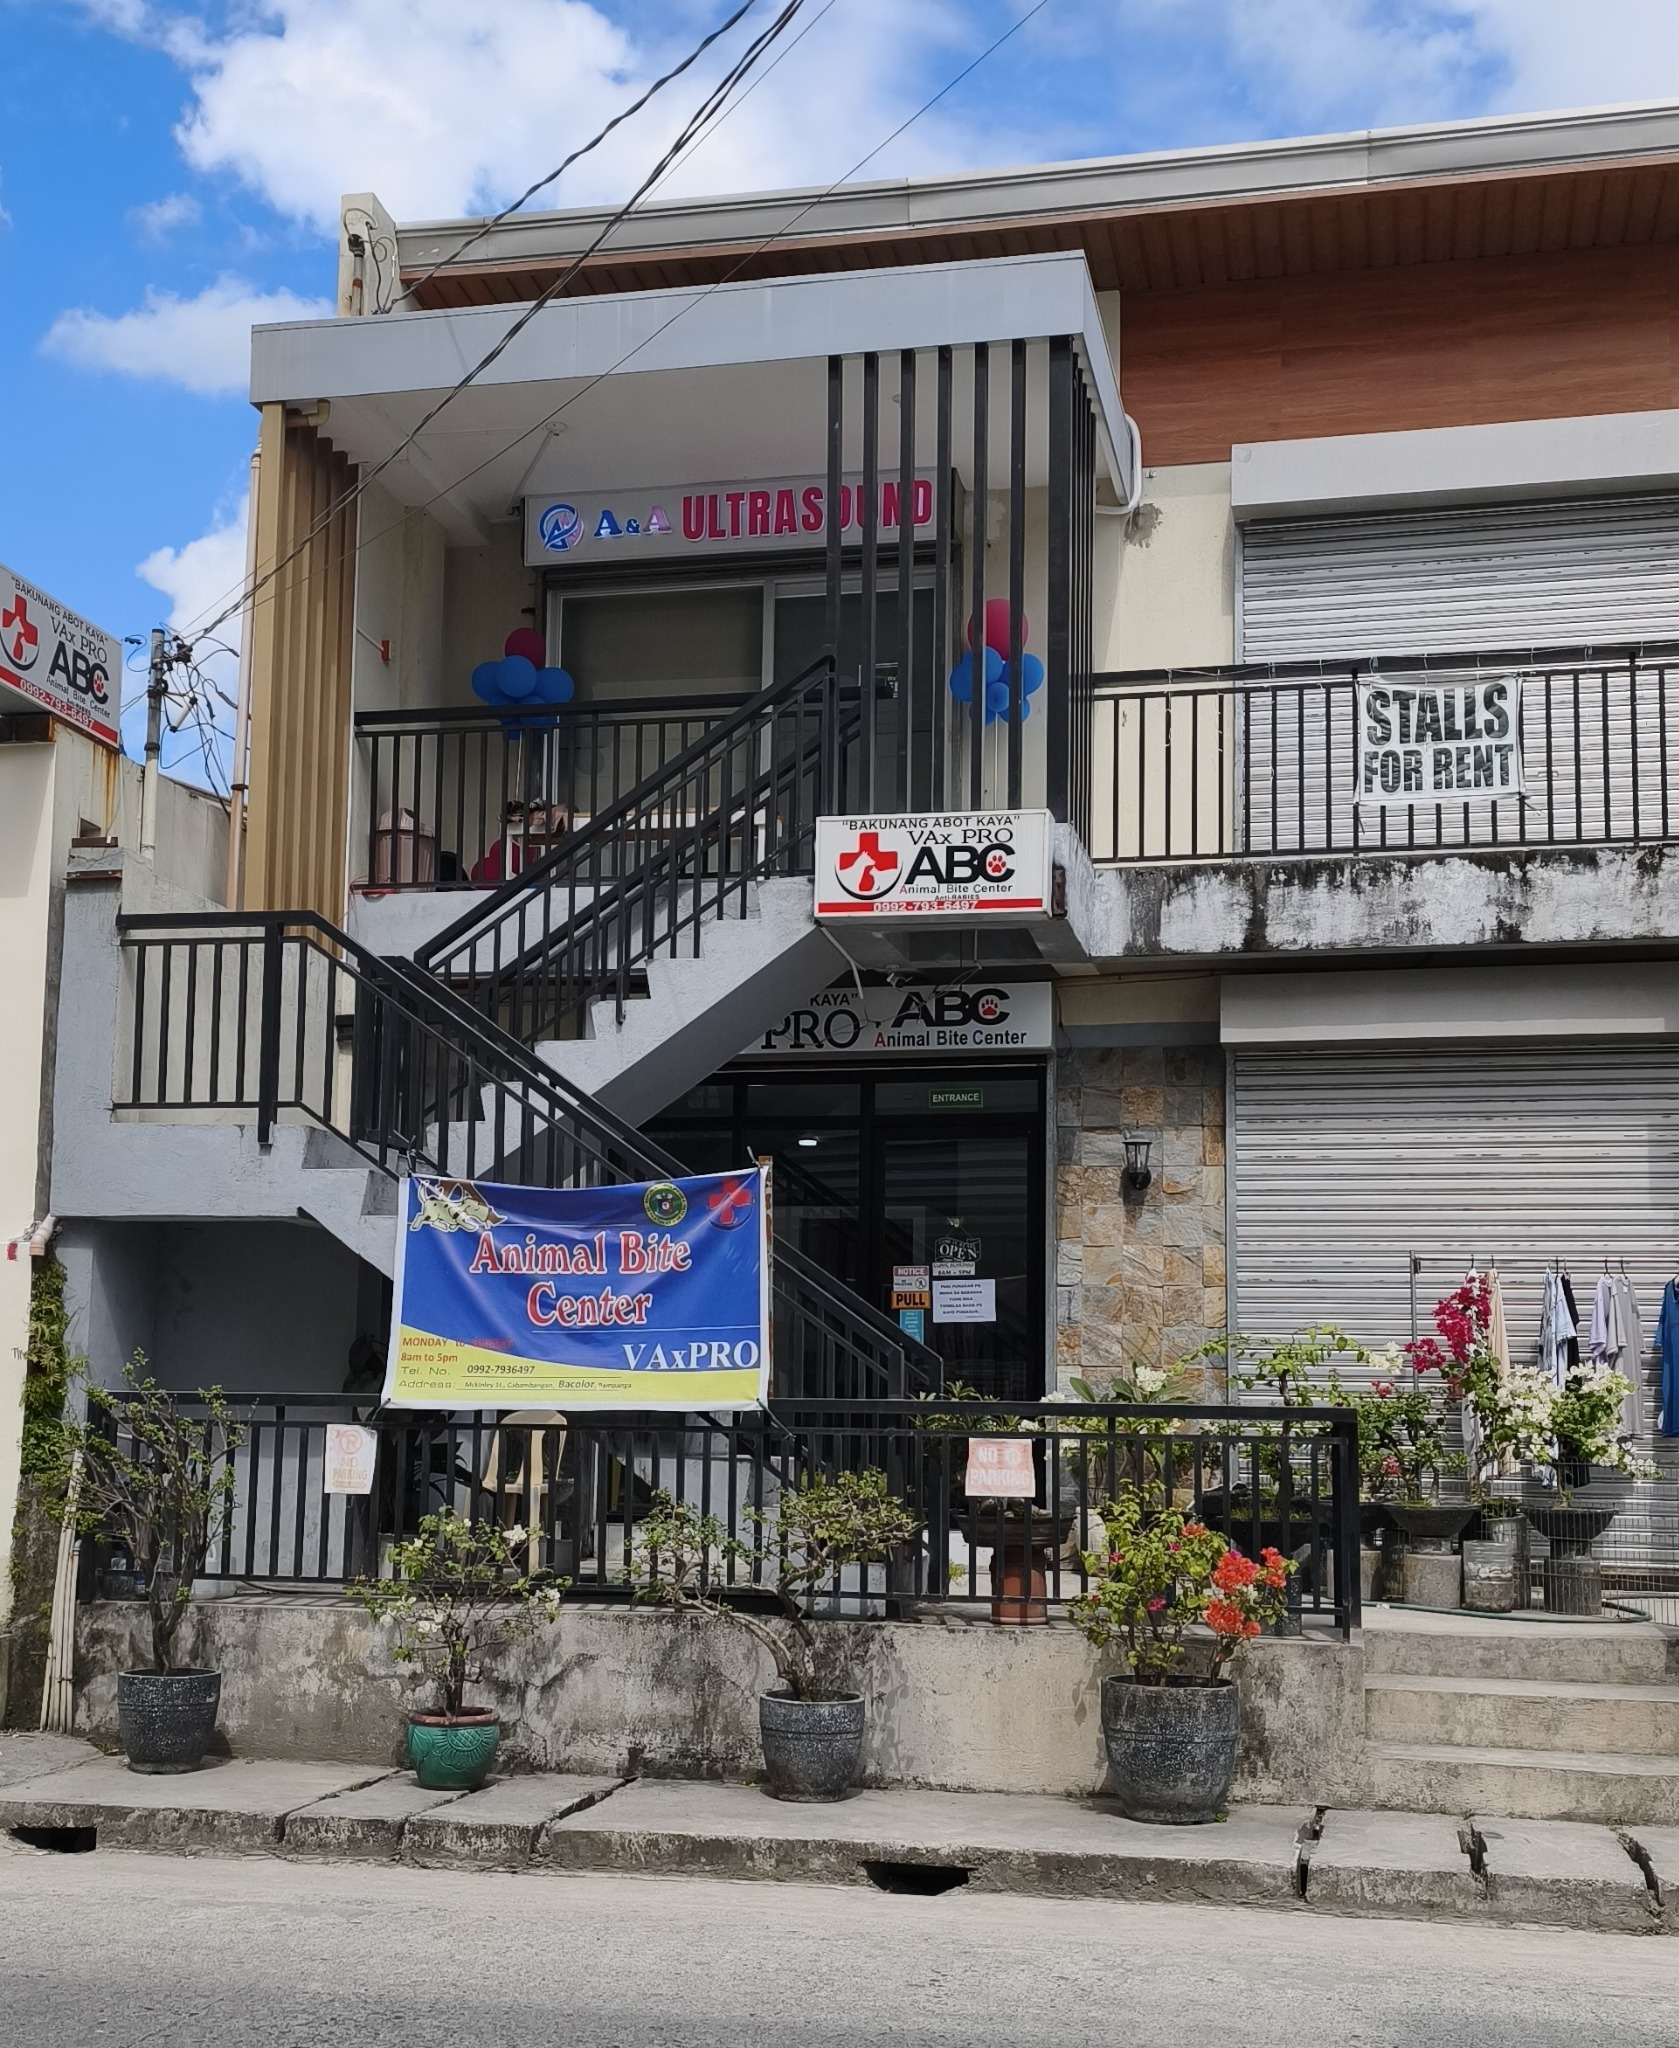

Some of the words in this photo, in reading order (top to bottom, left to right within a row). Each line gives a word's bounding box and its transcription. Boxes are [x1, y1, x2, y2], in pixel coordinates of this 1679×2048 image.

[63, 608, 84, 630] ABOT
[80, 636, 108, 664] PRO
[49, 640, 110, 704] ABC
[20, 678, 95, 729] 0992-793-6497
[46, 674, 69, 695] Animal
[73, 690, 86, 704] Bite
[90, 700, 111, 718] Center
[1366, 683, 1510, 746] STALLS
[1364, 750, 1423, 793] FOR
[1433, 744, 1514, 790] RENT
[934, 817, 972, 828] ABOT
[962, 828, 1013, 844] PRO
[904, 843, 1016, 885] ABC
[900, 885, 940, 894] Animal
[946, 884, 969, 894] Bite
[973, 884, 1013, 893] Center
[873, 901, 979, 912] 0992-793-6497
[891, 988, 1011, 1028] ABC
[761, 1009, 861, 1049] PRO
[875, 1031, 930, 1048] Animal
[937, 1030, 968, 1046] Bite
[972, 1029, 1027, 1046] Center
[932, 1093, 980, 1103] ENTRANCE
[469, 1230, 607, 1275] Animal
[618, 1230, 693, 1274] Bite
[940, 1244, 977, 1260] OPEN
[527, 1281, 653, 1327] Center
[896, 1293, 926, 1306] PULL
[402, 1338, 448, 1347] MONDAY
[400, 1353, 422, 1362] 8am
[424, 1353, 434, 1362] to
[437, 1353, 458, 1364] 5pm
[401, 1366, 423, 1375] Tel.
[429, 1367, 451, 1375] No.
[467, 1365, 536, 1374] 0992-7936497
[399, 1380, 457, 1389] Address:
[341, 1457, 358, 1468] NO
[978, 1447, 997, 1464] NO
[333, 1468, 368, 1480] PARKING
[970, 1468, 1031, 1487] PARKING
